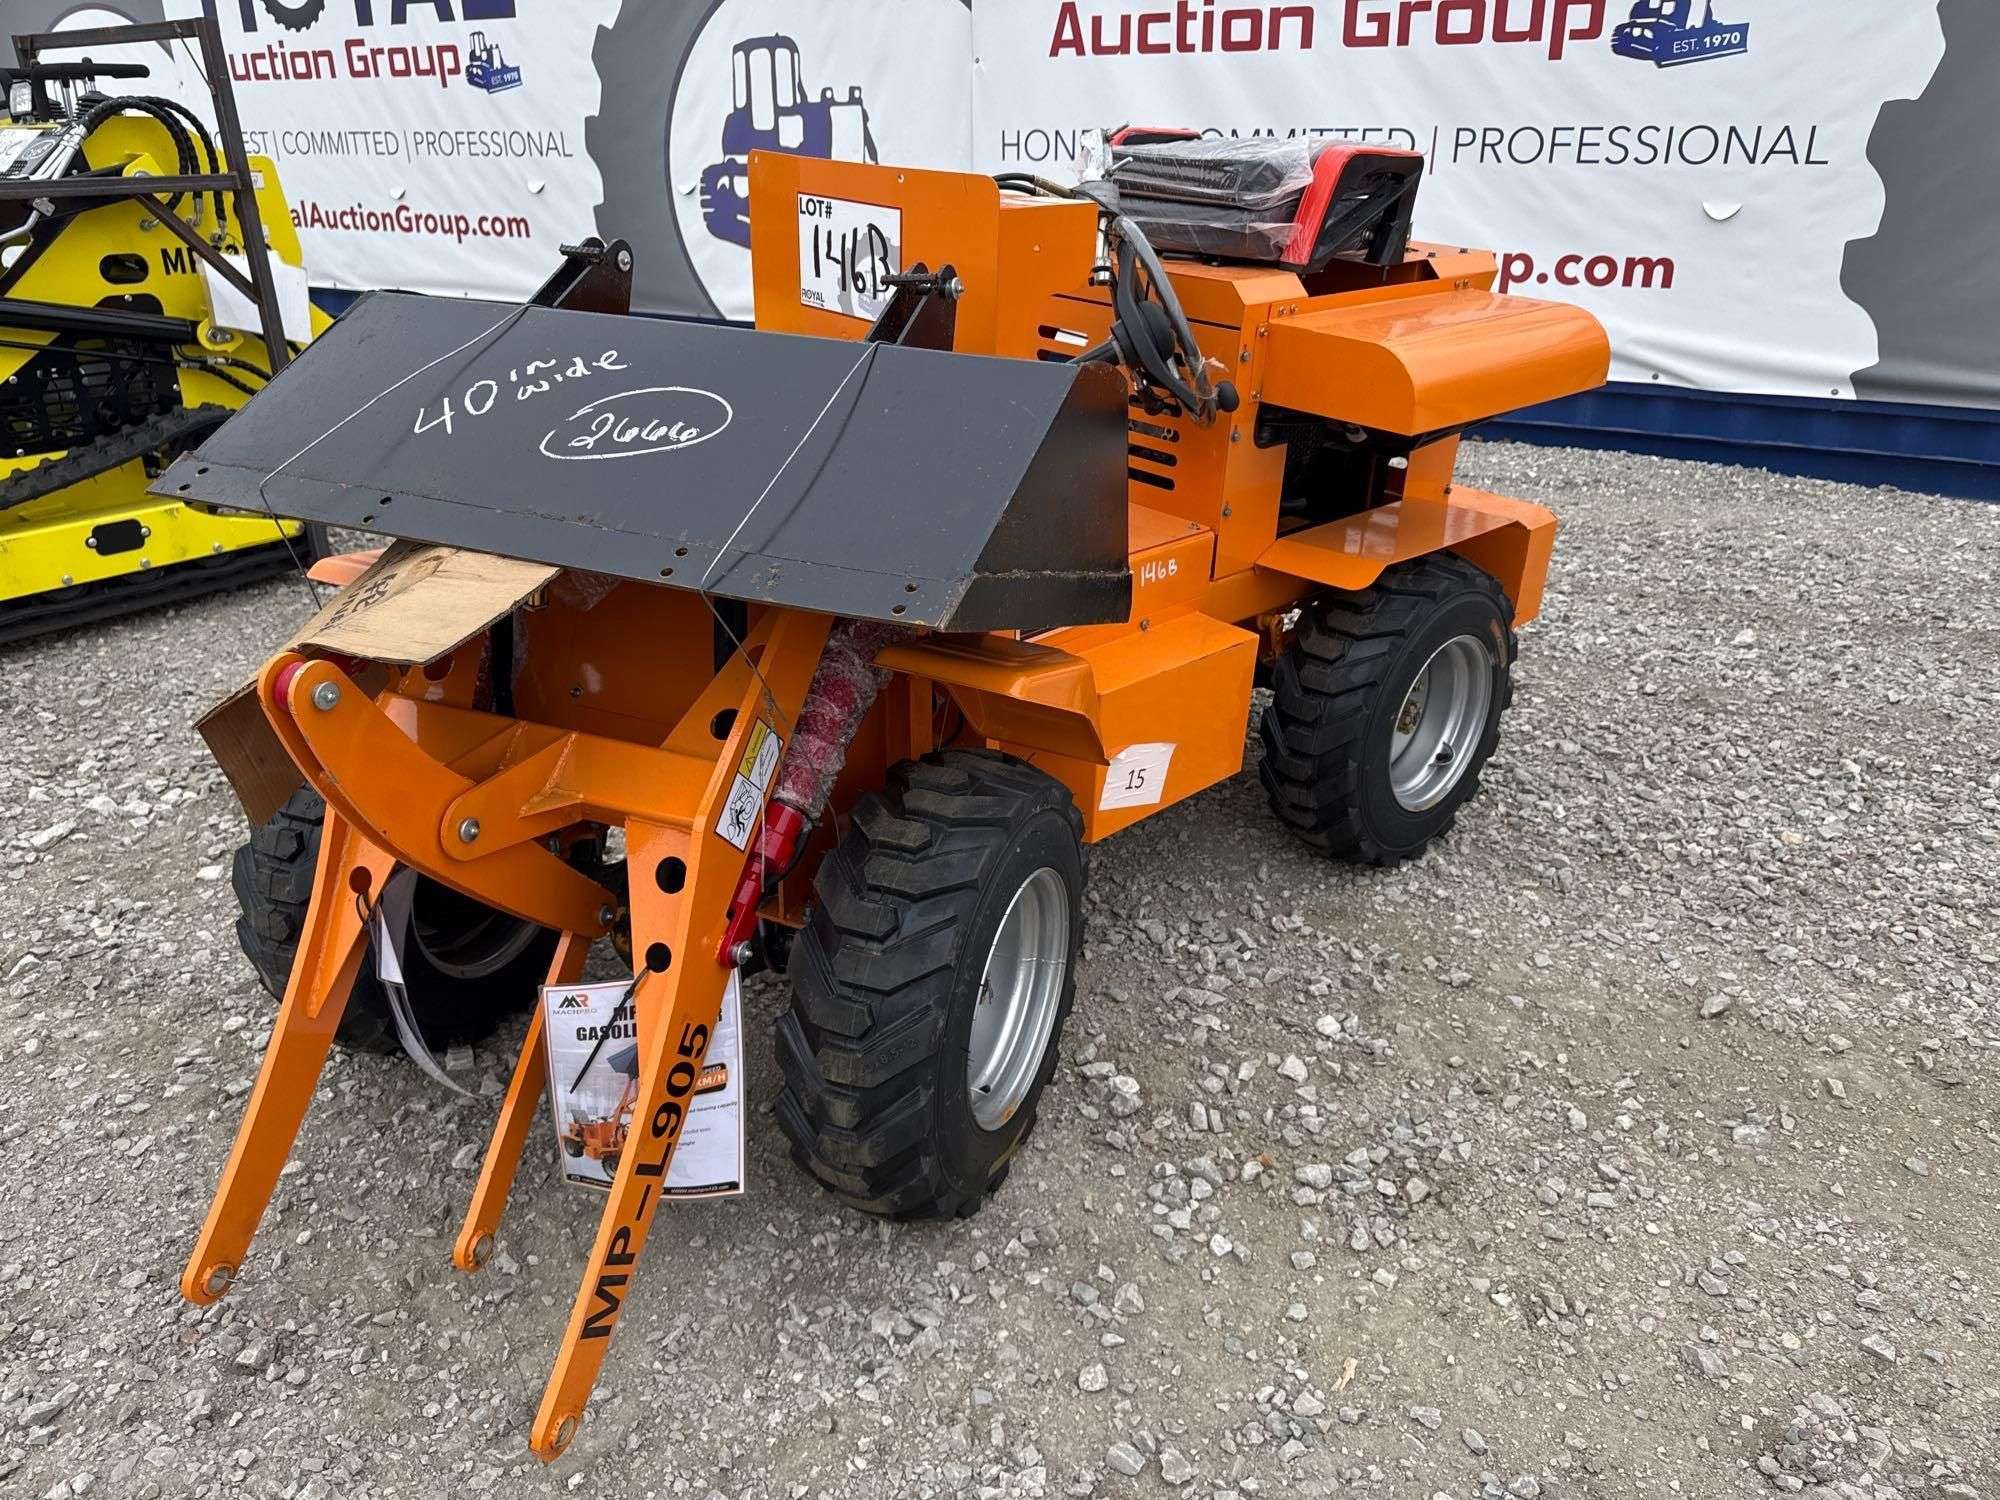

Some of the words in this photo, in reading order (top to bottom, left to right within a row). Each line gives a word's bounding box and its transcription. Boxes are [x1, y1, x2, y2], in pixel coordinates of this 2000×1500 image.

[1049, 1, 1314, 57] Auction
[1342, 0, 1606, 60] Group
[1672, 38, 1699, 53] EST.
[1704, 32, 1740, 48] 1970
[228, 39, 337, 81] uction
[344, 38, 462, 88] Group
[282, 130, 399, 156] COMMITTED
[414, 130, 573, 158] PROFESSIONAL
[1452, 124, 1829, 165] PROFESSIONAL
[291, 200, 531, 243] alAuctionGroup.com
[799, 196, 833, 219] LOT#
[413, 379, 498, 434] 40
[1140, 558, 1178, 586] 146B
[1125, 768, 1146, 790] 15
[576, 1023, 637, 1042] GASOLI
[579, 1022, 708, 1341] MP-L905
